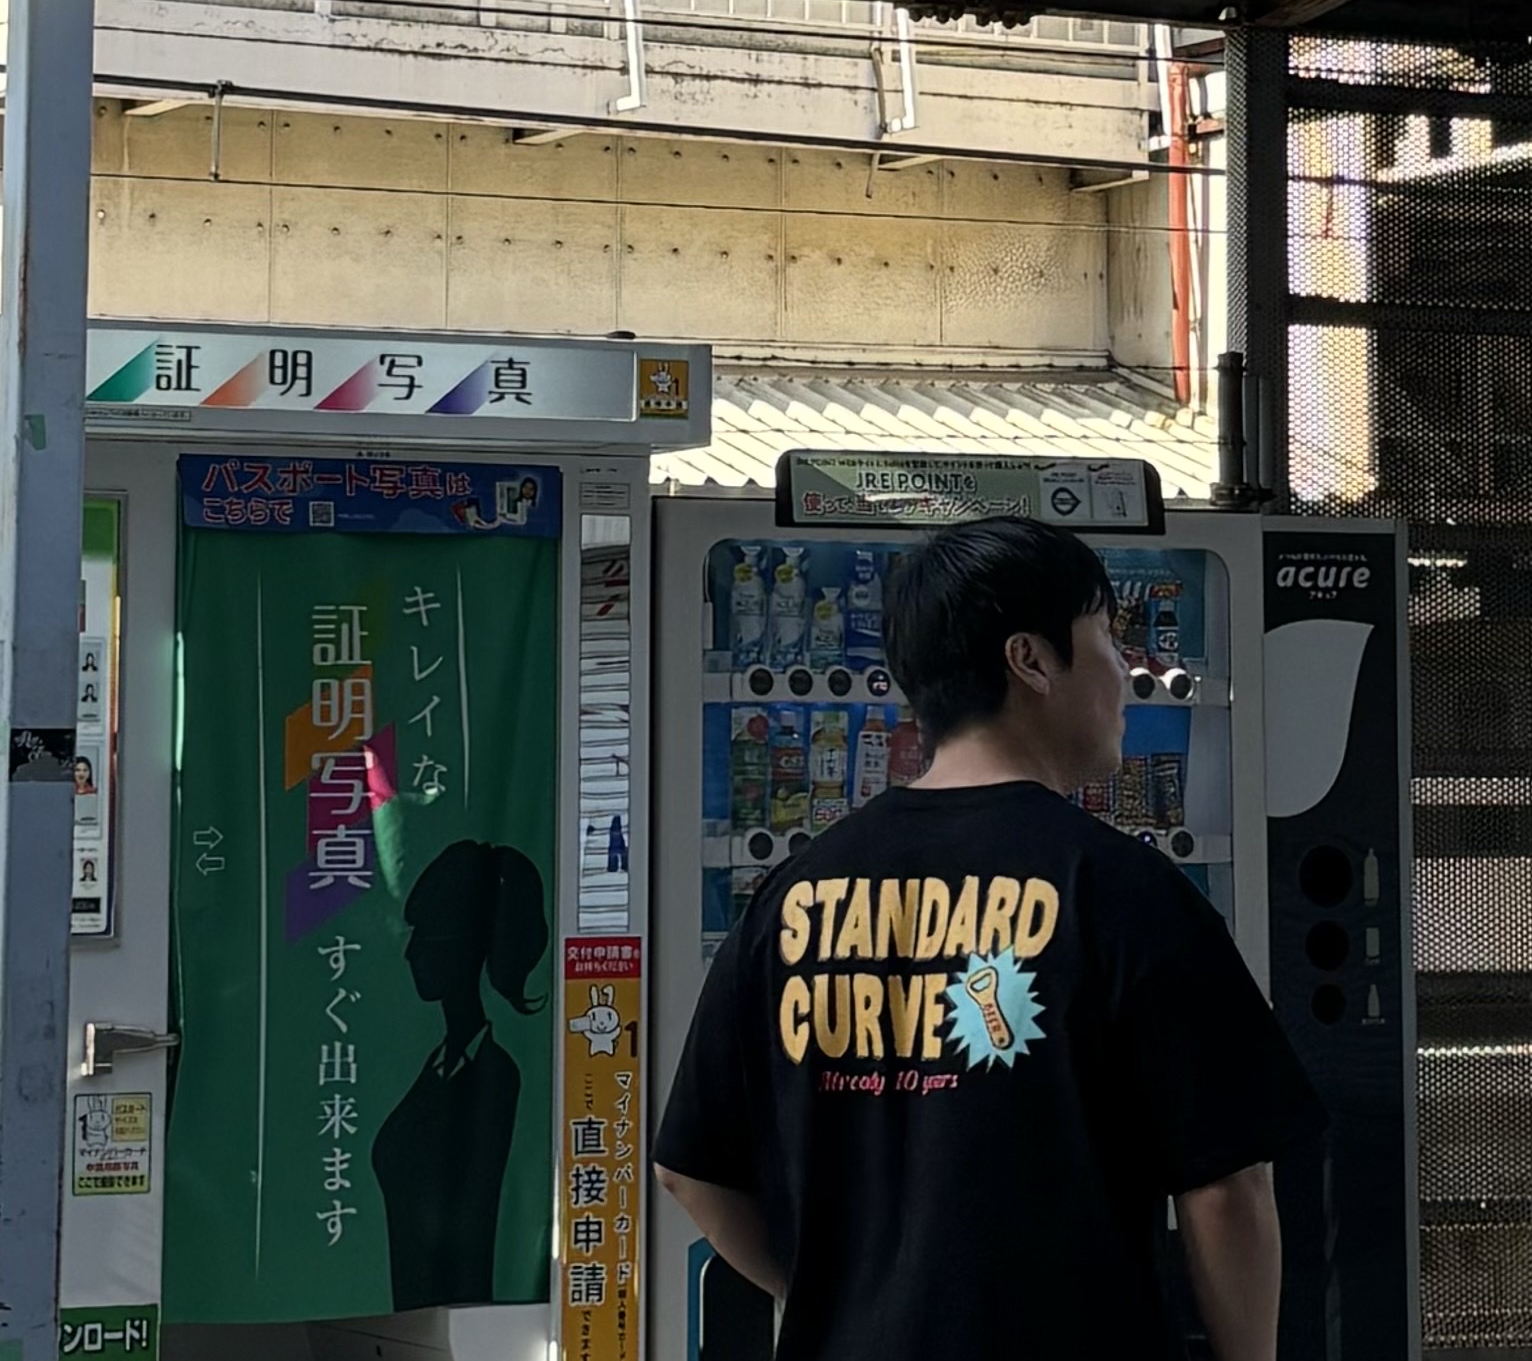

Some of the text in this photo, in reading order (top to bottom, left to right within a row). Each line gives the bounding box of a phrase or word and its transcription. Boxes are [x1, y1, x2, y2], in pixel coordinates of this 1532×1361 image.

[154, 344, 533, 406] 証明写真
[201, 460, 472, 500] パスポート写真は
[202, 497, 294, 526] こちらで
[856, 471, 891, 490] JRE
[1276, 566, 1371, 588] acure
[402, 585, 448, 794] キレイな
[308, 604, 376, 890] 証明写真
[779, 875, 1060, 966] STANDARD
[779, 971, 948, 1065] CURVE
[316, 934, 362, 1247] すぐ出来ます
[819, 1070, 886, 1096] Already
[895, 1070, 919, 1091] 10
[568, 1115, 610, 1308] 直接申請
[614, 1070, 633, 1286] マイナンバーカード
[58, 1319, 148, 1353] ンロード!
